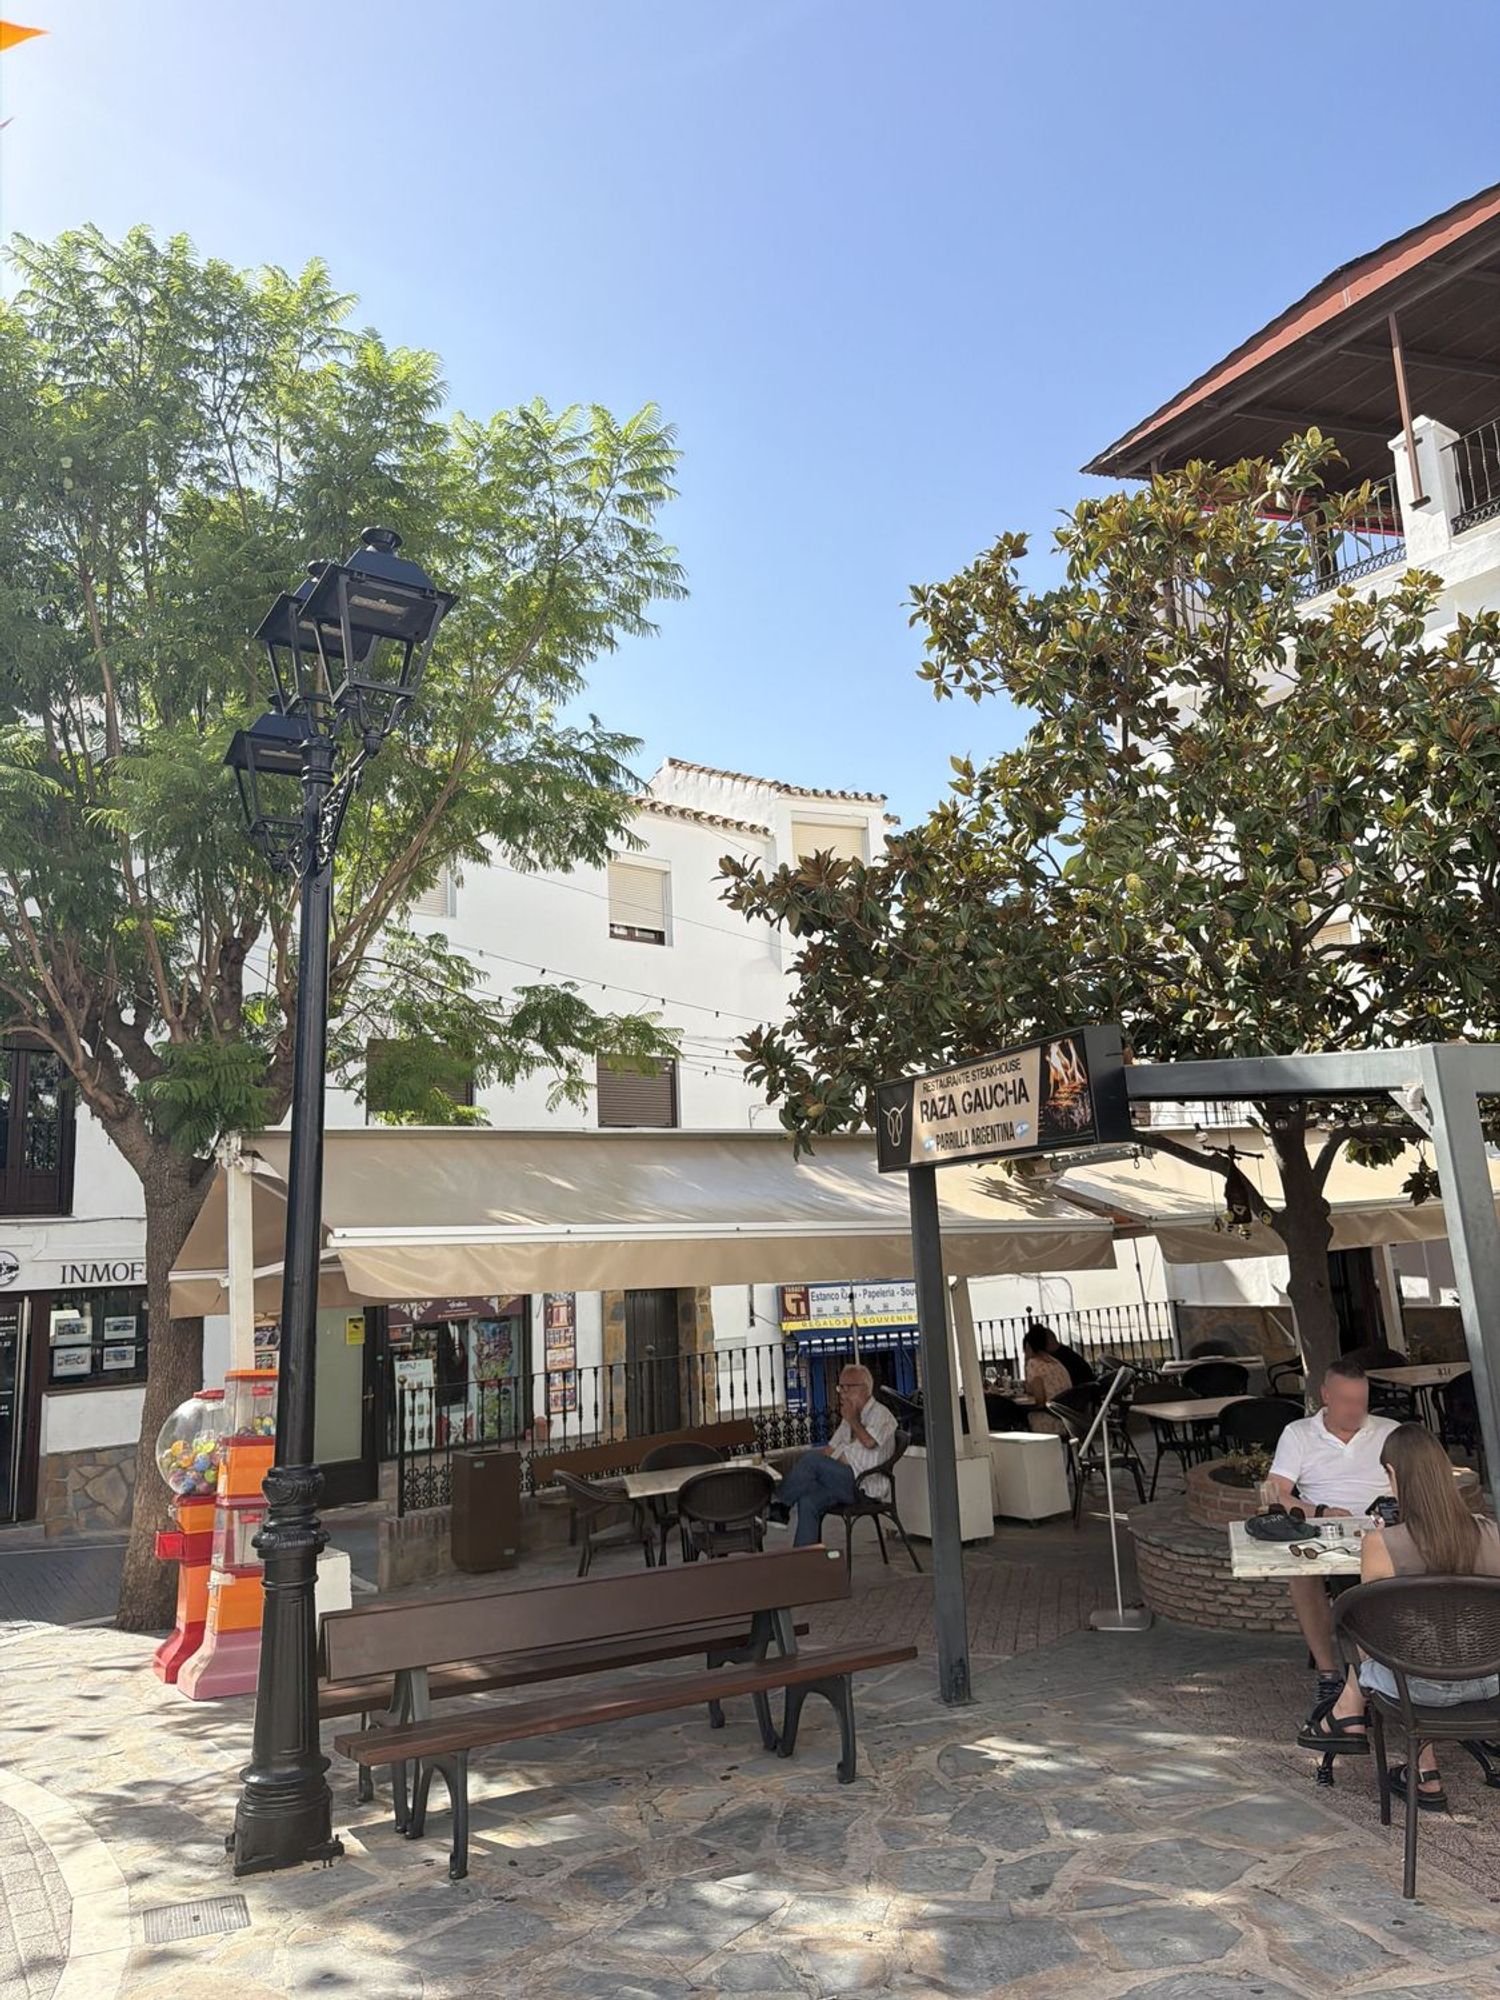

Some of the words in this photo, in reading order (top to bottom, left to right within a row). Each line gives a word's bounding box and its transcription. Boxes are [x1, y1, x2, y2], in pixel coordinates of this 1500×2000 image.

[923, 1072, 970, 1093] RESTAURANTE
[972, 1059, 1021, 1081] STEAKHOUSE
[920, 1094, 957, 1123] RAZA
[961, 1077, 1030, 1114] GAUCHA
[935, 1130, 970, 1151] PARRILLA
[971, 1121, 1016, 1146] ARGENTINA
[61, 1262, 147, 1284] INMOF
[811, 1291, 839, 1301] Estanco
[863, 1287, 895, 1300] Papelería
[802, 1319, 848, 1327] REGALOS
[863, 1314, 914, 1324] SOUVENIR
